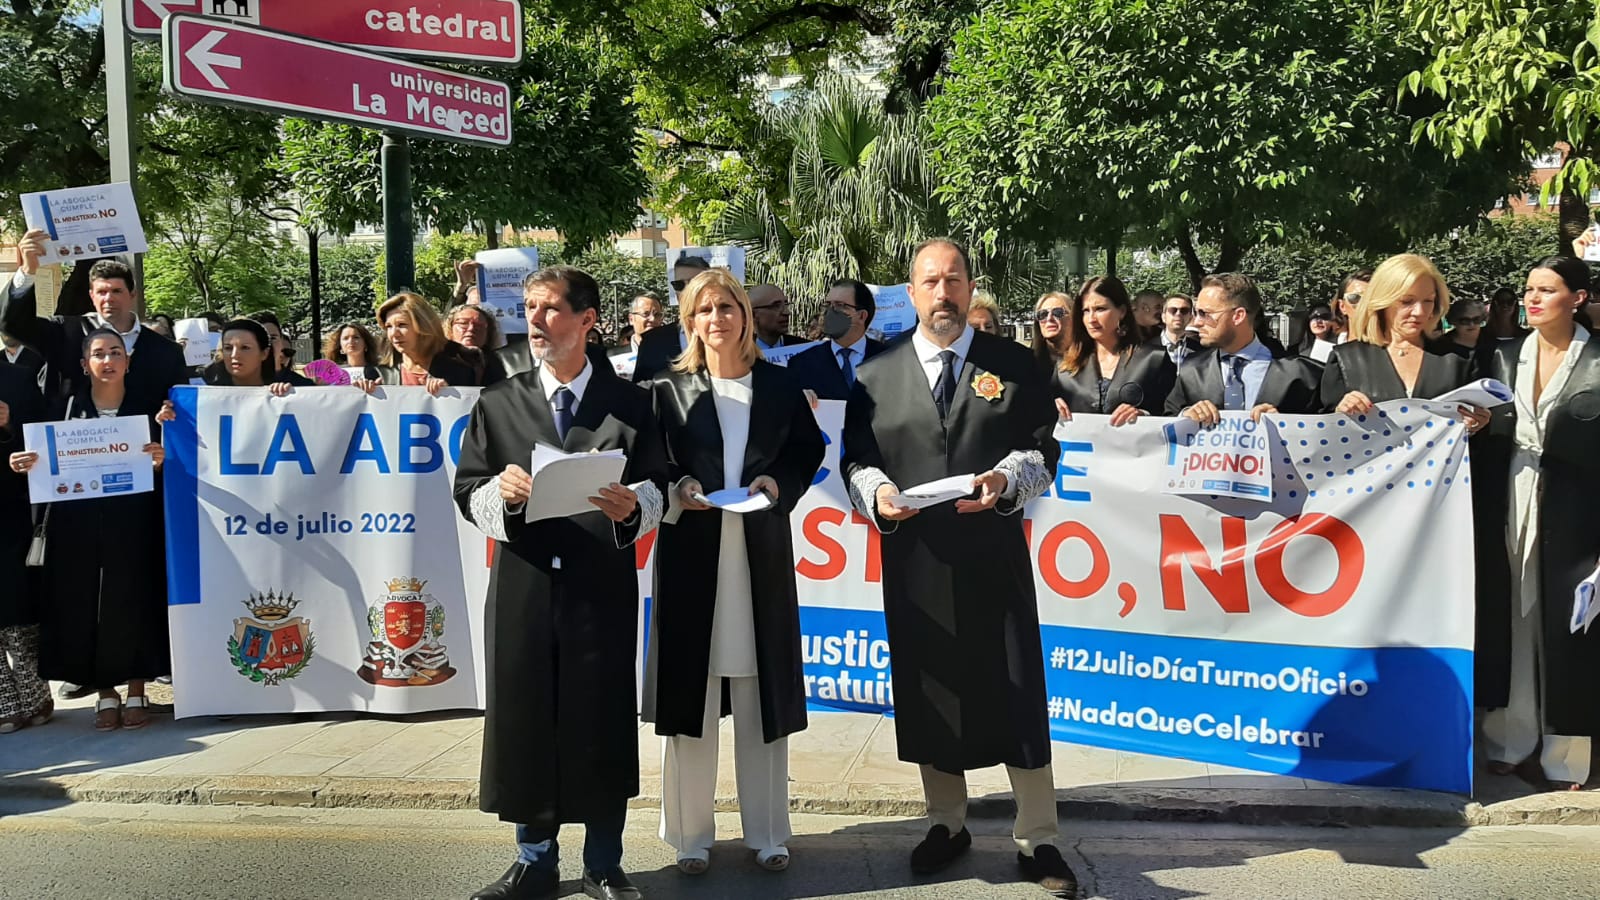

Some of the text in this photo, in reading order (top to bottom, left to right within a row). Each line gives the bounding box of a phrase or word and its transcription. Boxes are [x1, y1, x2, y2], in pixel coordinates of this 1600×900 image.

[365, 7, 511, 43] catedral
[352, 83, 387, 115] La
[390, 71, 504, 108] universidad
[49, 199, 60, 207] LA
[60, 203, 95, 213] CUMPLE
[98, 208, 117, 219] NO
[66, 436, 104, 445] CUMPLE
[70, 426, 119, 438] ABOGACÍA
[219, 413, 316, 475] LA
[1186, 433, 1266, 450] DE OFICIO
[109, 443, 129, 453] NO
[1182, 453, 1264, 476] ¡DIGNO!
[224, 511, 416, 541] 12 de julio 2022
[1159, 512, 1365, 617] NO
[1050, 646, 1368, 697] #12JulioDíaTurnoOficio
[1047, 695, 1325, 748] #NadaQueCelebrar
